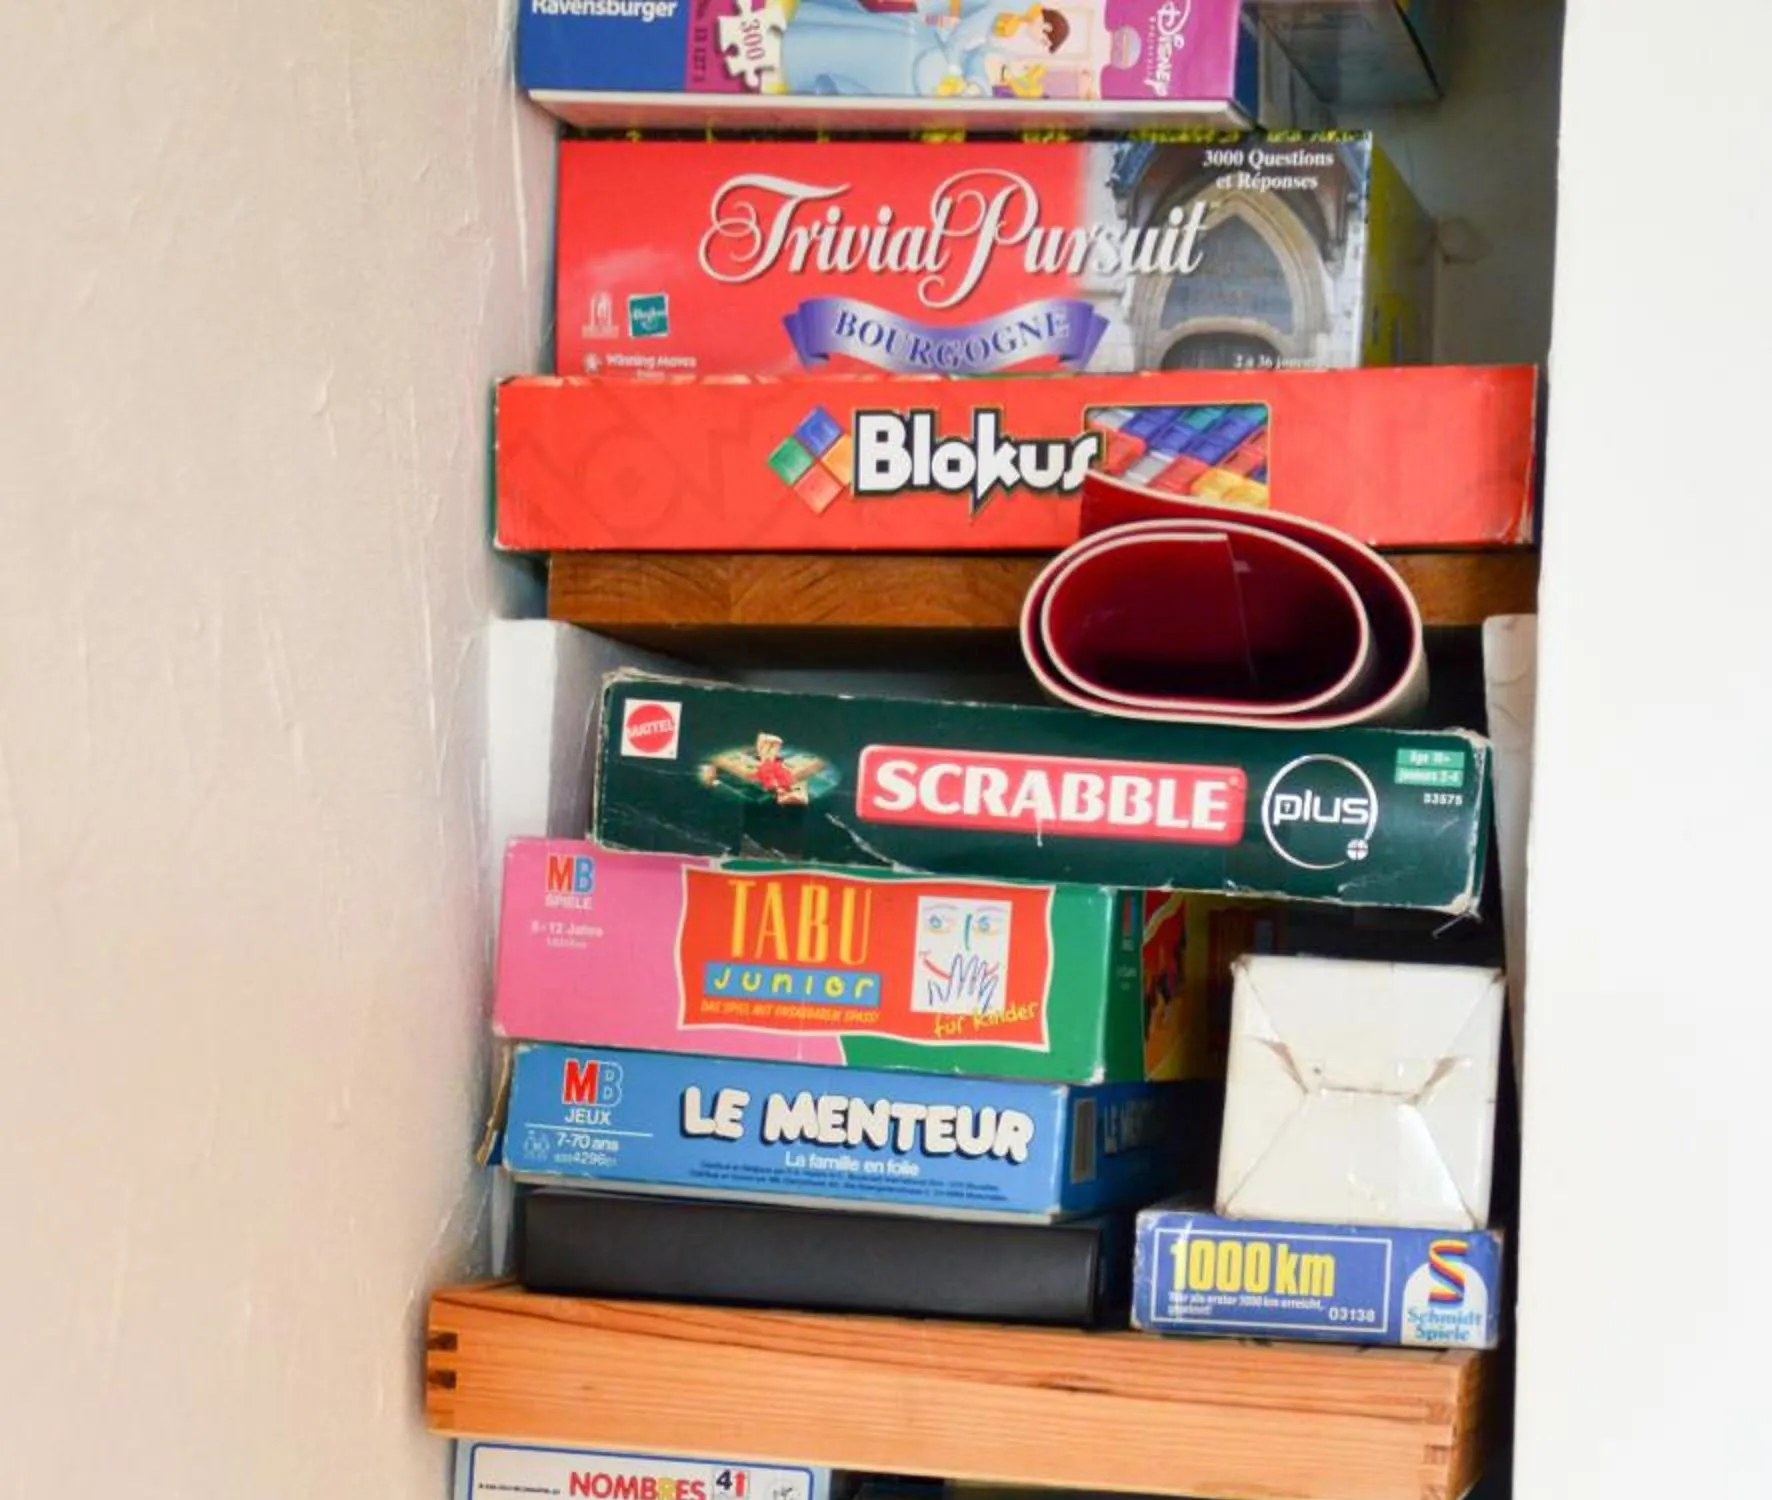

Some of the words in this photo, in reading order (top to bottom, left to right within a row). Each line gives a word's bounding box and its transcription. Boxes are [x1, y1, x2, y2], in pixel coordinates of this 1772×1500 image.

[532, 0, 677, 21] Ravensburger
[741, 18, 766, 60] 300
[1203, 149, 1243, 166] 3000
[1248, 149, 1334, 171] Questions
[1216, 173, 1233, 189] et
[1237, 171, 1319, 192] Réponses
[699, 173, 950, 283] Trivial
[917, 167, 1209, 310] Pursuit
[834, 306, 1069, 372] BOURGOGNE
[855, 408, 1098, 518] Blokus
[627, 718, 676, 739] MATTEL
[872, 759, 1232, 834] SCRABBLE
[1272, 788, 1370, 826] plus
[546, 853, 596, 896] MB
[544, 893, 594, 911] SPIELE
[727, 878, 873, 966] TABU
[562, 1057, 624, 1108] MB
[563, 1108, 612, 1127] JEUX
[683, 1085, 751, 1140] LE
[762, 1090, 1035, 1167] MENTEUR
[556, 1131, 591, 1150] 7-70
[591, 1138, 620, 1152] ans
[785, 1150, 805, 1168] La
[808, 1153, 860, 1172] famille
[863, 1158, 887, 1174] en
[887, 1156, 920, 1177] folie
[1169, 1237, 1272, 1294] 1000
[1274, 1243, 1335, 1297] km
[1406, 1306, 1484, 1327] Schmidt
[1413, 1325, 1471, 1342] Spiele
[714, 1469, 733, 1491] 4
